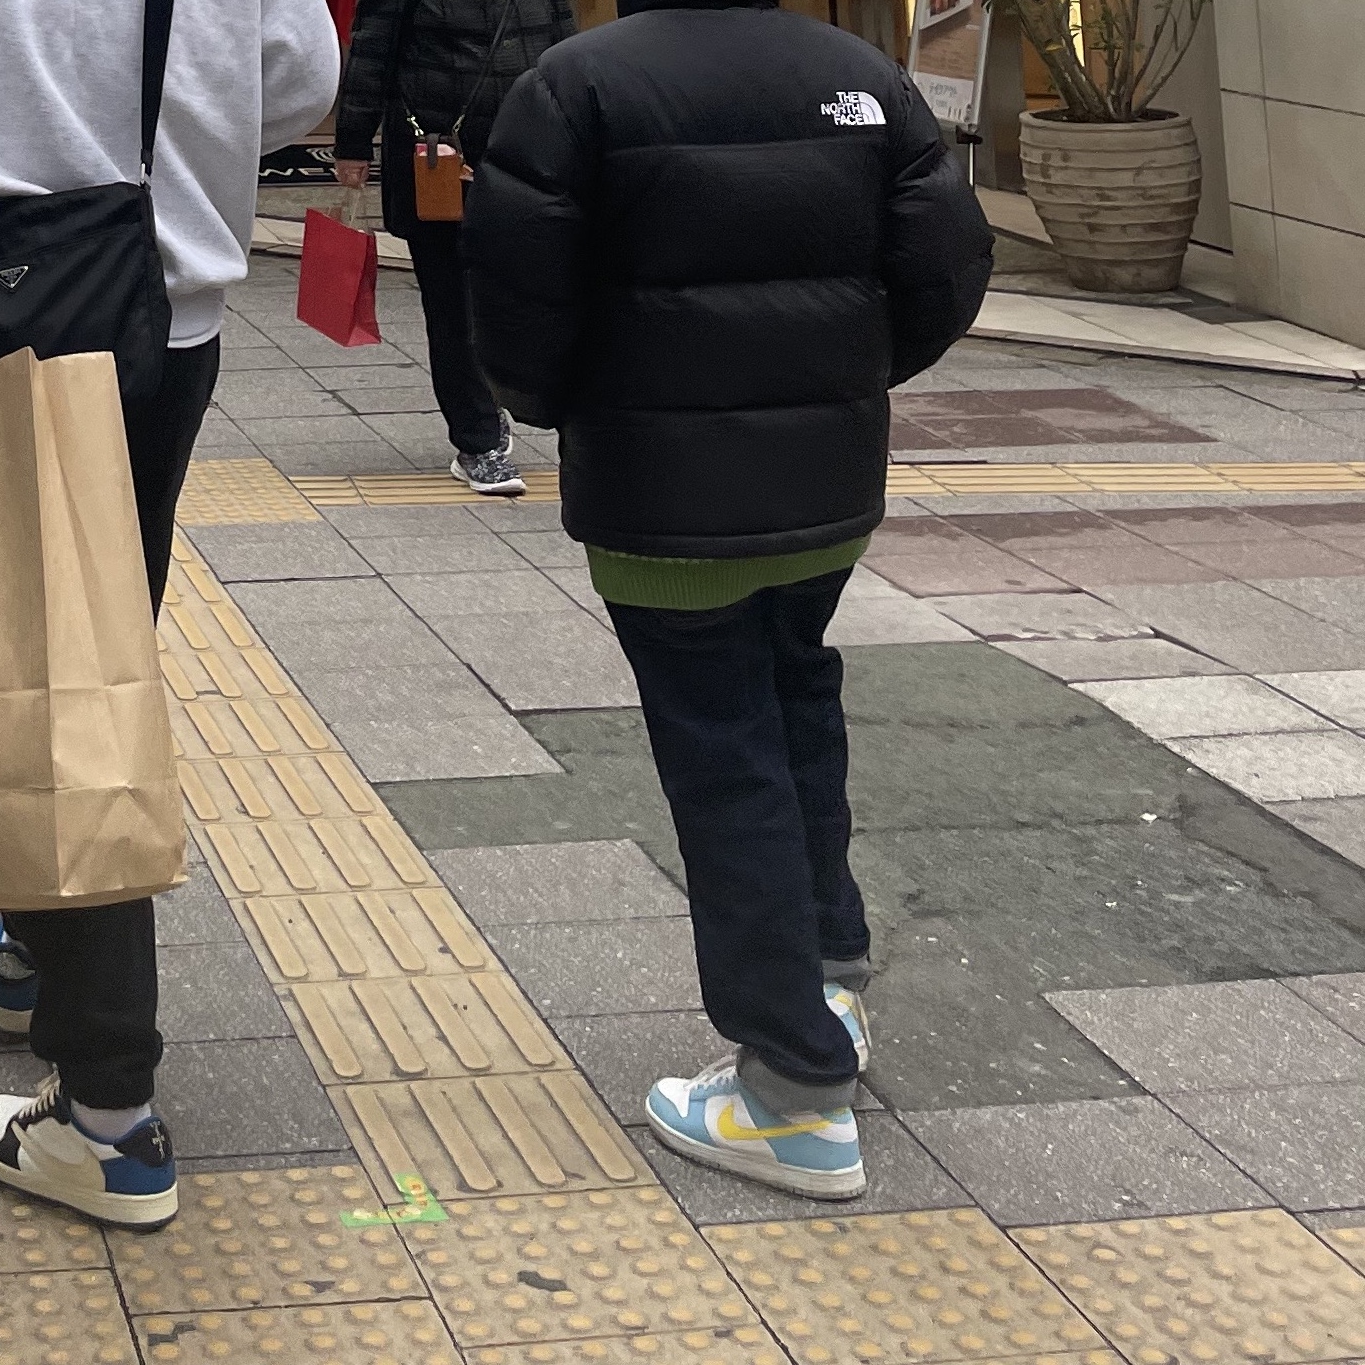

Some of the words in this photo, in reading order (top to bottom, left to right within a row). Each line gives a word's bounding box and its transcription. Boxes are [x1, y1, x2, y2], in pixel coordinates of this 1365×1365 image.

[835, 91, 859, 103] THE
[820, 102, 861, 115] NORTH
[834, 114, 865, 125] FACE
